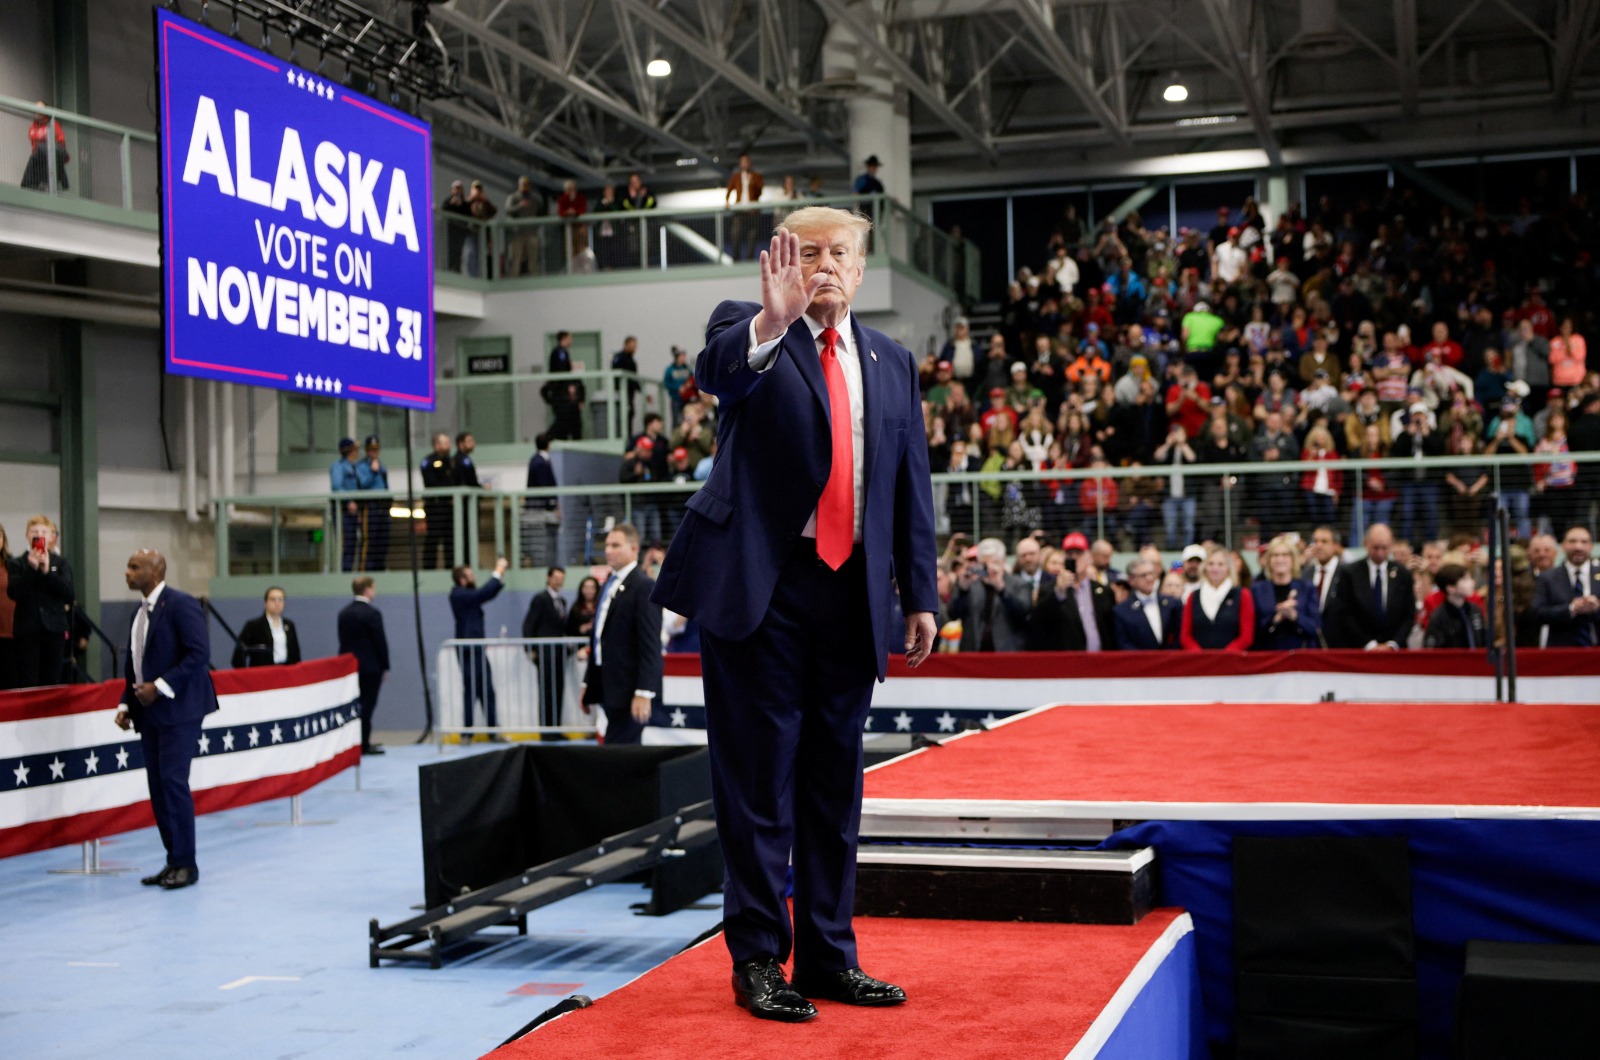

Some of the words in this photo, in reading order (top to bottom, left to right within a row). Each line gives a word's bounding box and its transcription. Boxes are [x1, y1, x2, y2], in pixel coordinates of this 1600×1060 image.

[183, 95, 420, 253] ALASKA
[255, 219, 328, 279] VOTE
[334, 243, 371, 290] ON
[187, 257, 390, 354] NOVEMBER
[396, 307, 422, 361] 3!
